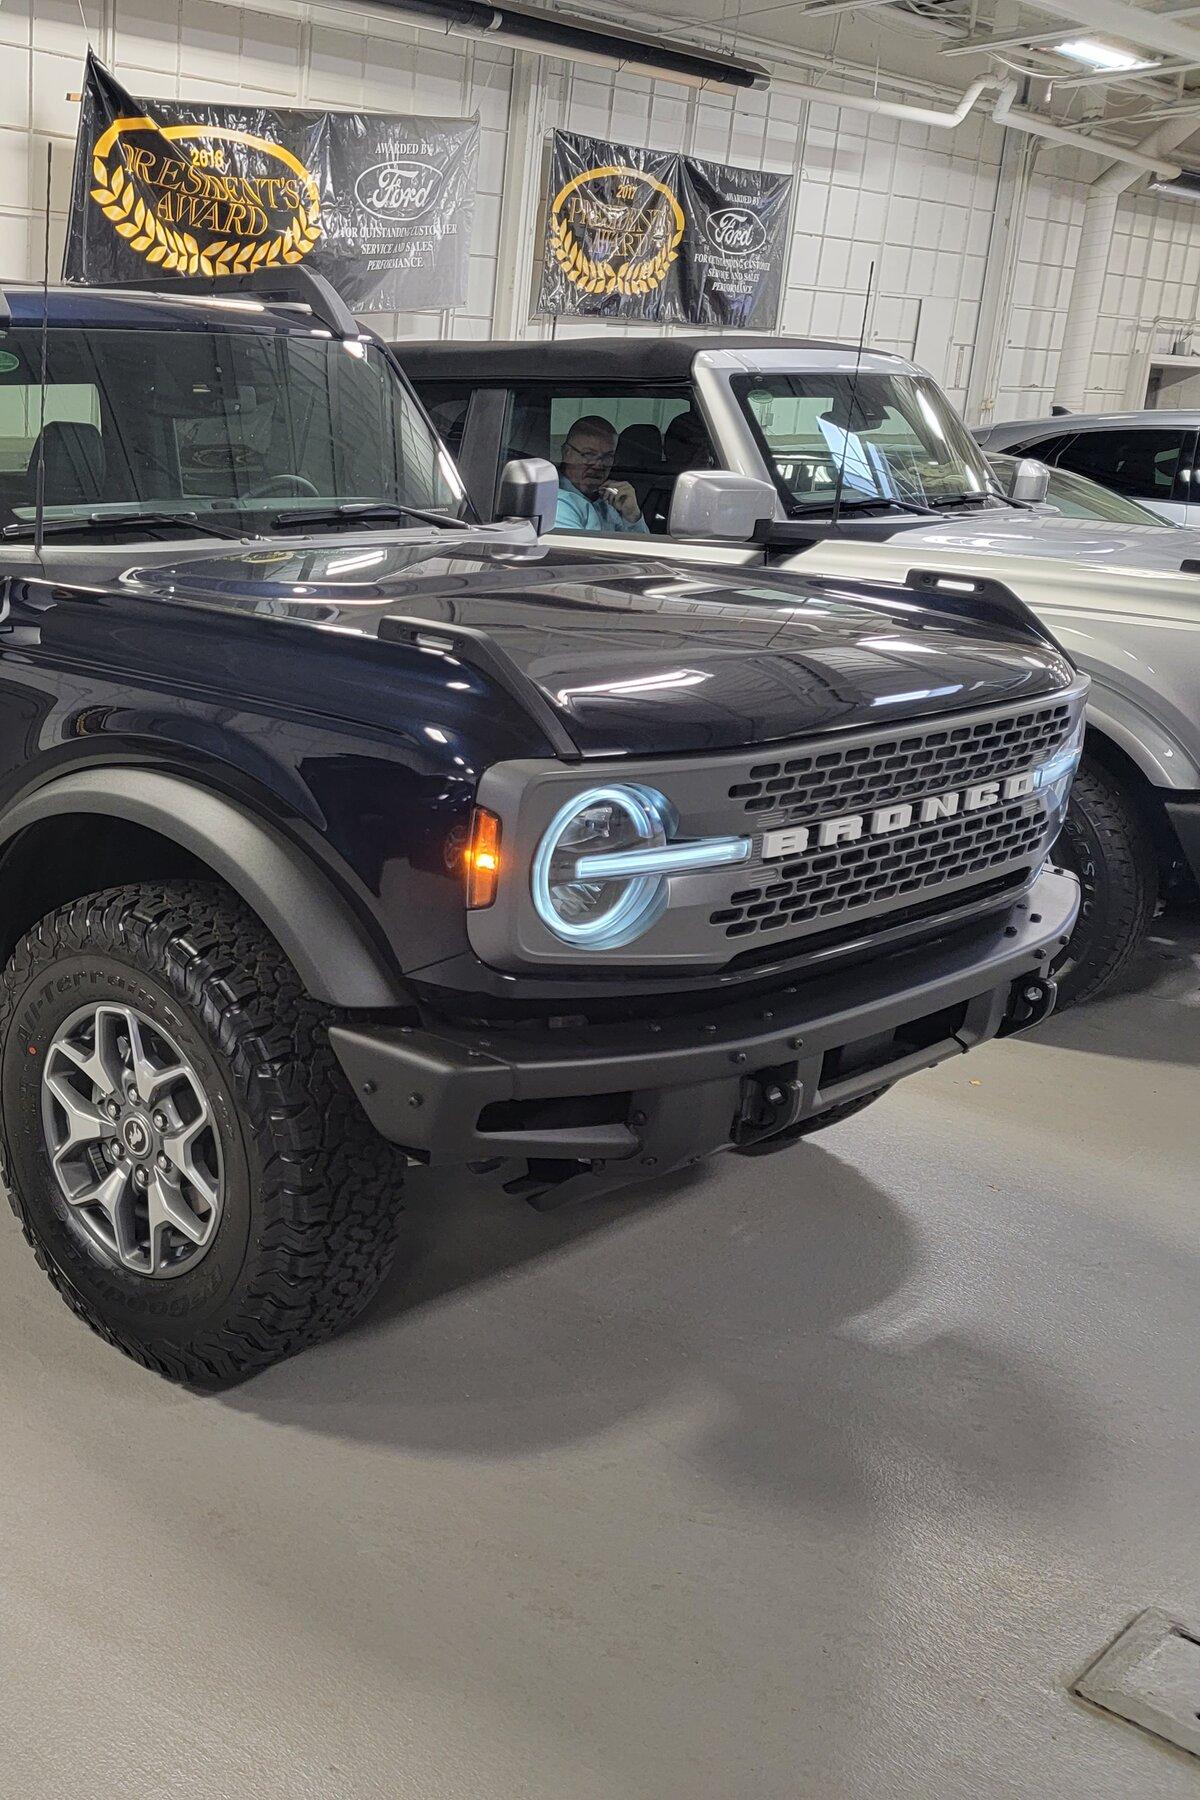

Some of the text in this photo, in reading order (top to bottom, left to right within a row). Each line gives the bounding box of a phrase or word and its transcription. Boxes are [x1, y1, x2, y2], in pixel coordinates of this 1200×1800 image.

[372, 168, 434, 208] Ford
[157, 191, 269, 236] AWARD
[714, 212, 754, 246] Ford
[405, 240, 434, 252] SALES
[761, 773, 1037, 860] BRONCO
